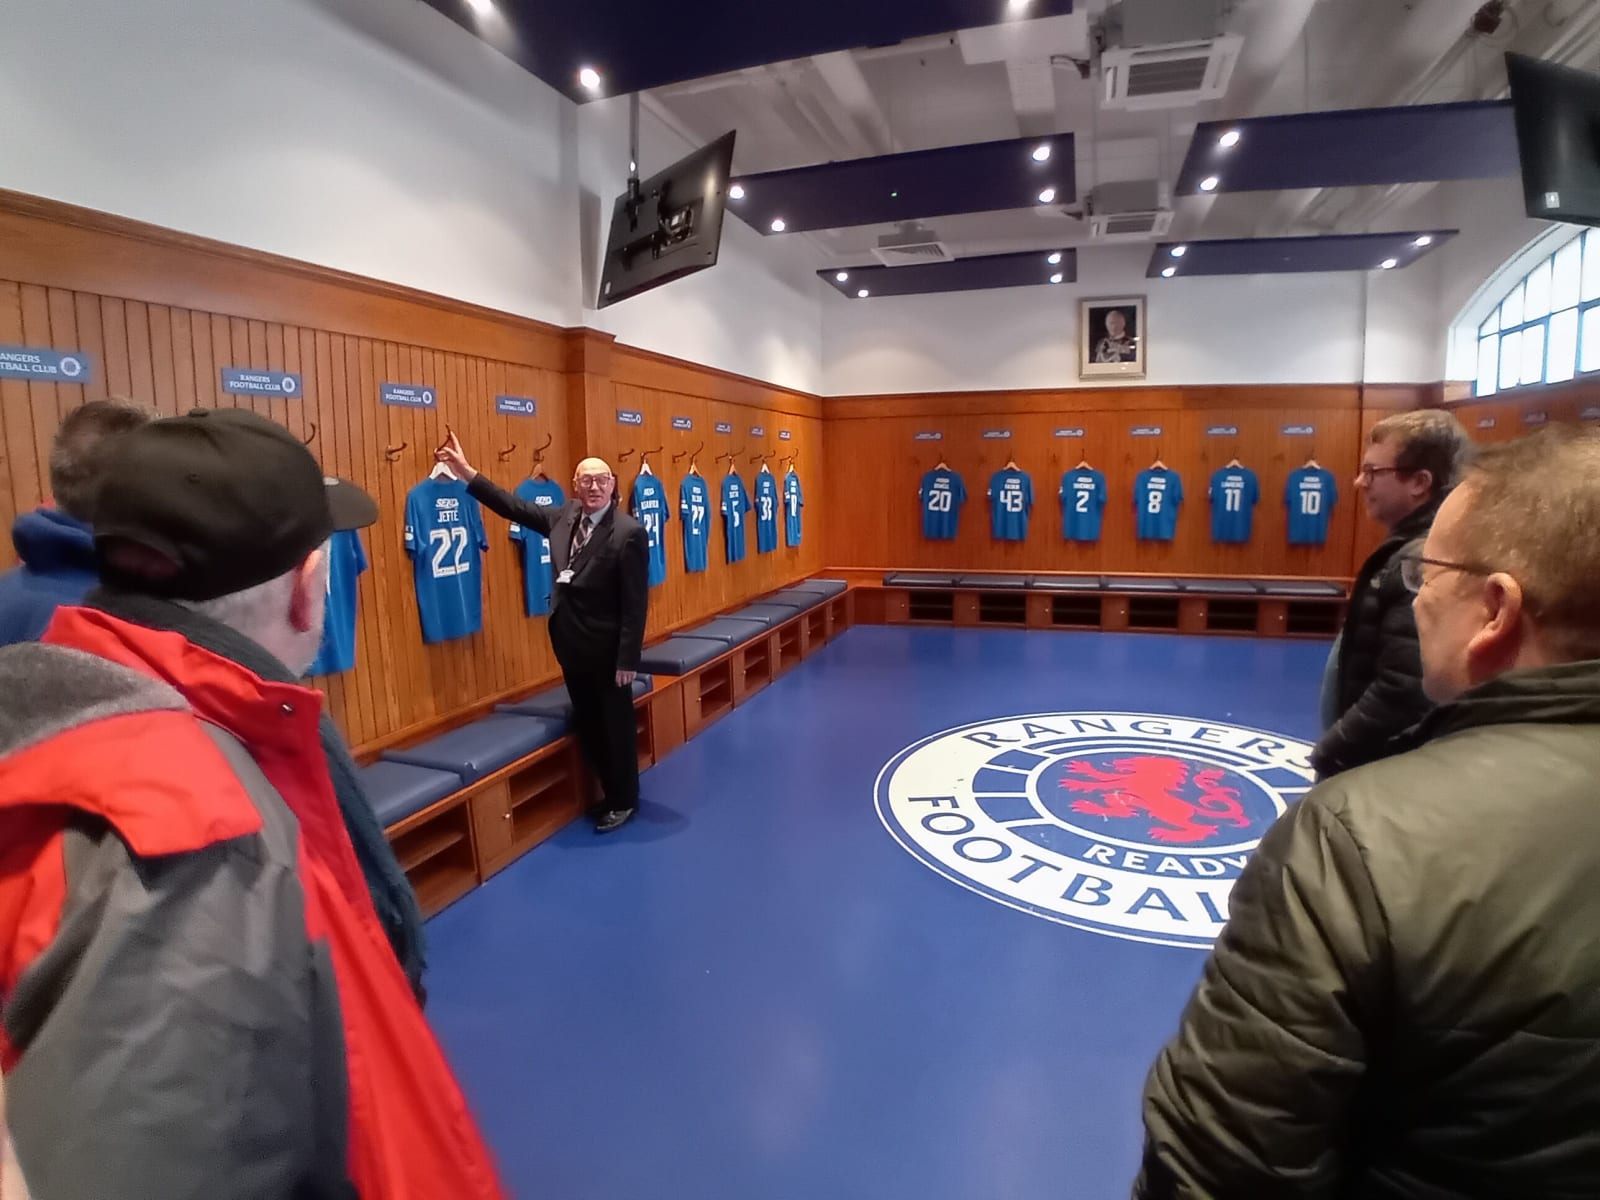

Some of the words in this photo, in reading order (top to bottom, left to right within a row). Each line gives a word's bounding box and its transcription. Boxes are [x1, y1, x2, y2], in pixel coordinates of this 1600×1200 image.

[0, 353, 40, 363] ANGERS
[32, 364, 58, 374] CLUB
[229, 381, 264, 390] FOOTBALL
[264, 383, 281, 391] CLUB
[240, 374, 271, 383] RANGERS
[928, 489, 952, 512] 20
[1000, 490, 1023, 513] 43
[1075, 490, 1090, 513] 2
[1147, 490, 1163, 514] 8
[1224, 488, 1241, 512] 11
[1300, 490, 1321, 515] 10
[429, 526, 470, 578] 22
[908, 795, 1229, 924] FOOTBAL
[1083, 843, 1248, 877] READY
